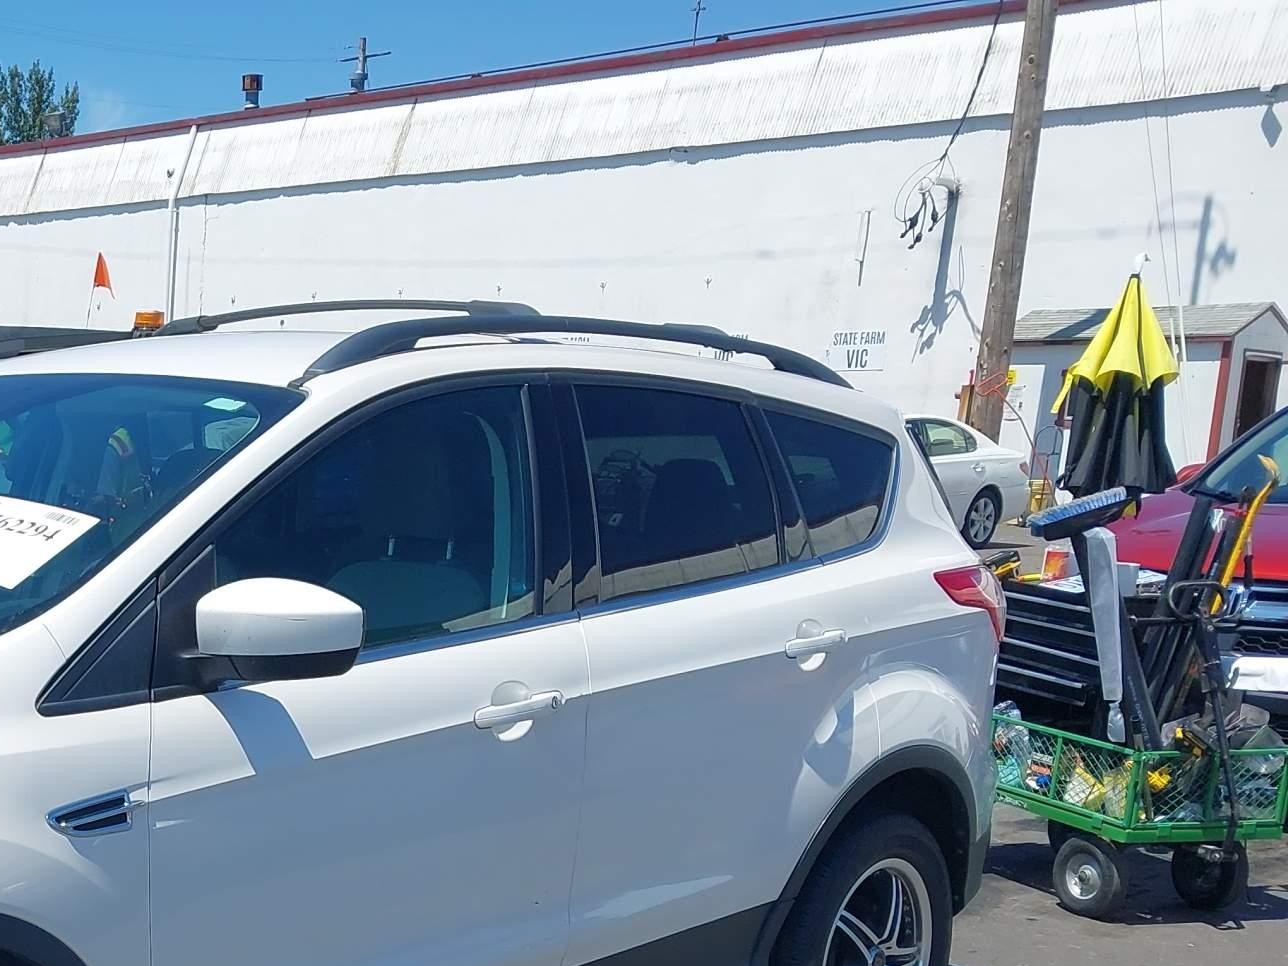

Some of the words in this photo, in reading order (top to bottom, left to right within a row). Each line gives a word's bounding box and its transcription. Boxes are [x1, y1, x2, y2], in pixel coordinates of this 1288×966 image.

[833, 332, 859, 346] STATE
[860, 330, 886, 345] FARM
[846, 348, 869, 368] VIC
